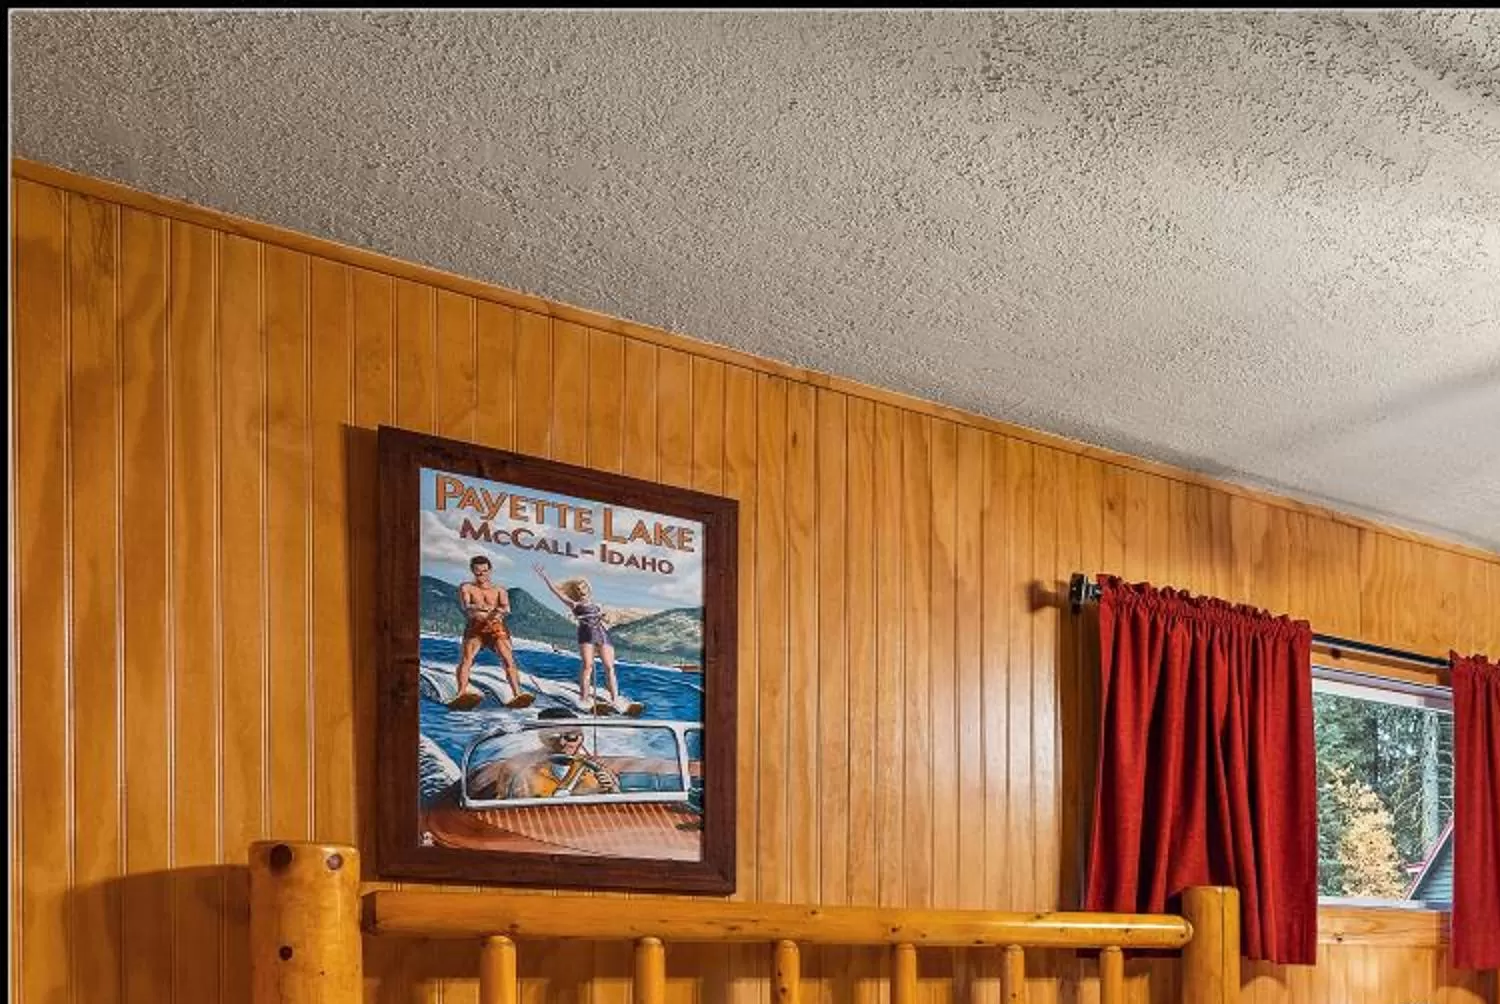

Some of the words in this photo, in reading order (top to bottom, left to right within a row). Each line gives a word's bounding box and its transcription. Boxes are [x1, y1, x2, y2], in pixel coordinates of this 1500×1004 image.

[435, 473, 595, 535] PAYETTE
[603, 506, 695, 553] LAKE
[599, 543, 675, 575] IDAHO
